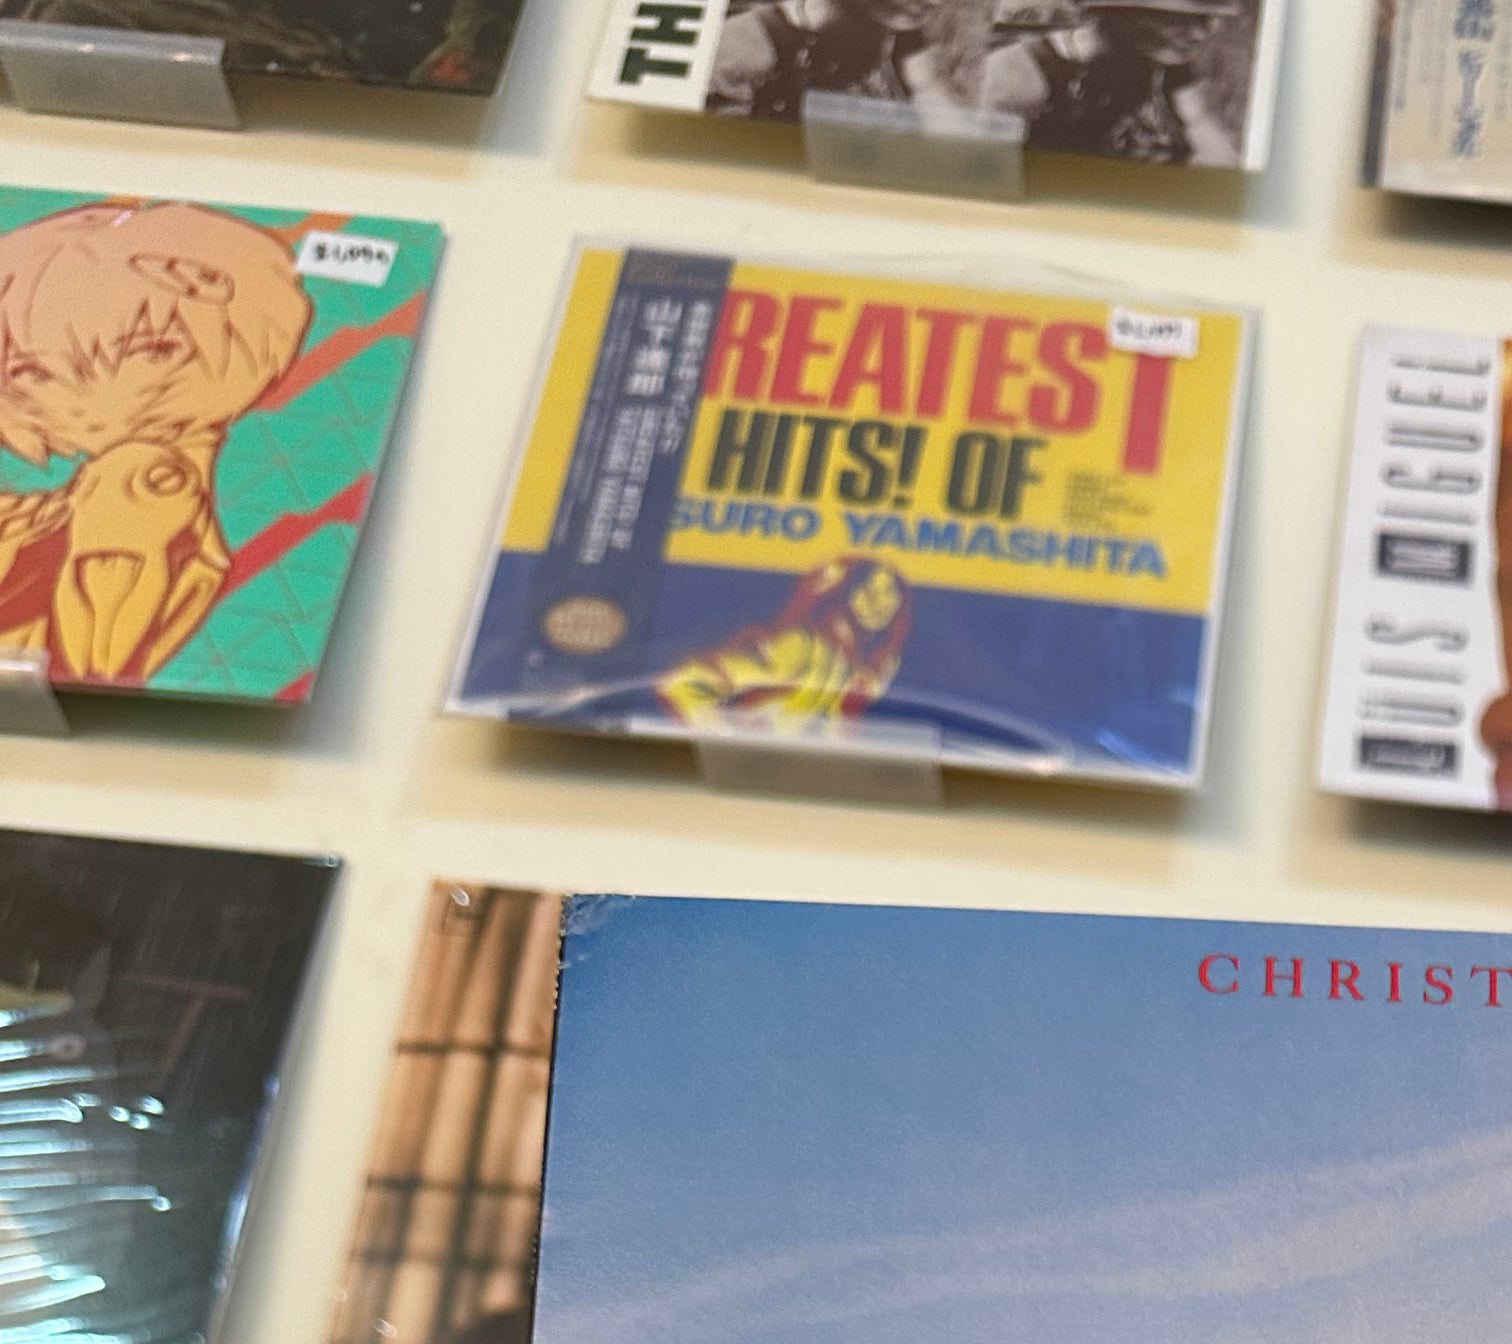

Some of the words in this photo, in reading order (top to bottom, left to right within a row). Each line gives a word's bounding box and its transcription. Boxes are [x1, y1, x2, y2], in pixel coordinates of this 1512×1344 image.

[706, 408, 928, 508] HITS!
[945, 431, 1050, 522] OF
[842, 510, 1168, 580] YAMASHITA
